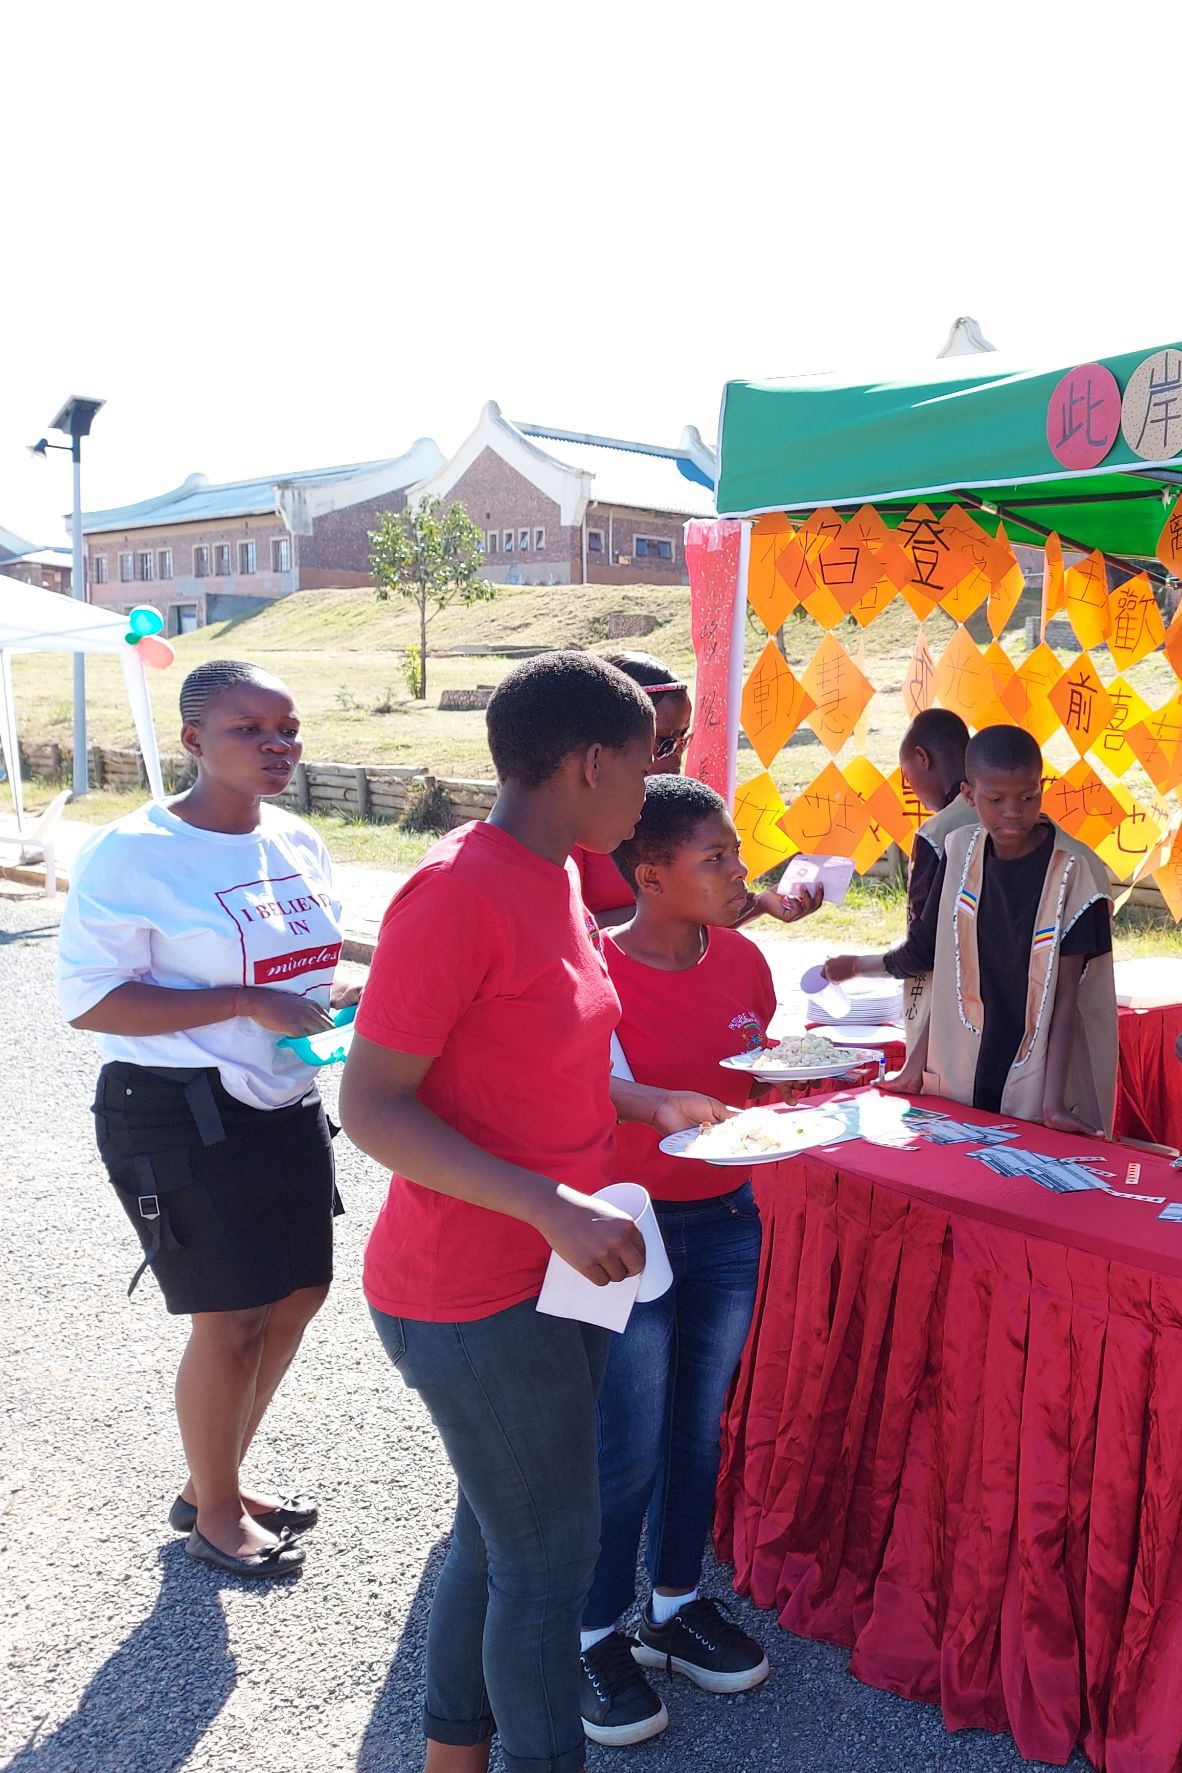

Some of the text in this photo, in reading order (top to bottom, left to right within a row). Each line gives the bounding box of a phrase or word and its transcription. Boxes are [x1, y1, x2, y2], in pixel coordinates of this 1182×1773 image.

[1066, 671, 1099, 734] 前
[1055, 783, 1113, 822] 地
[241, 908, 254, 922] I
[288, 920, 311, 935] IN
[267, 947, 337, 976] miracles
